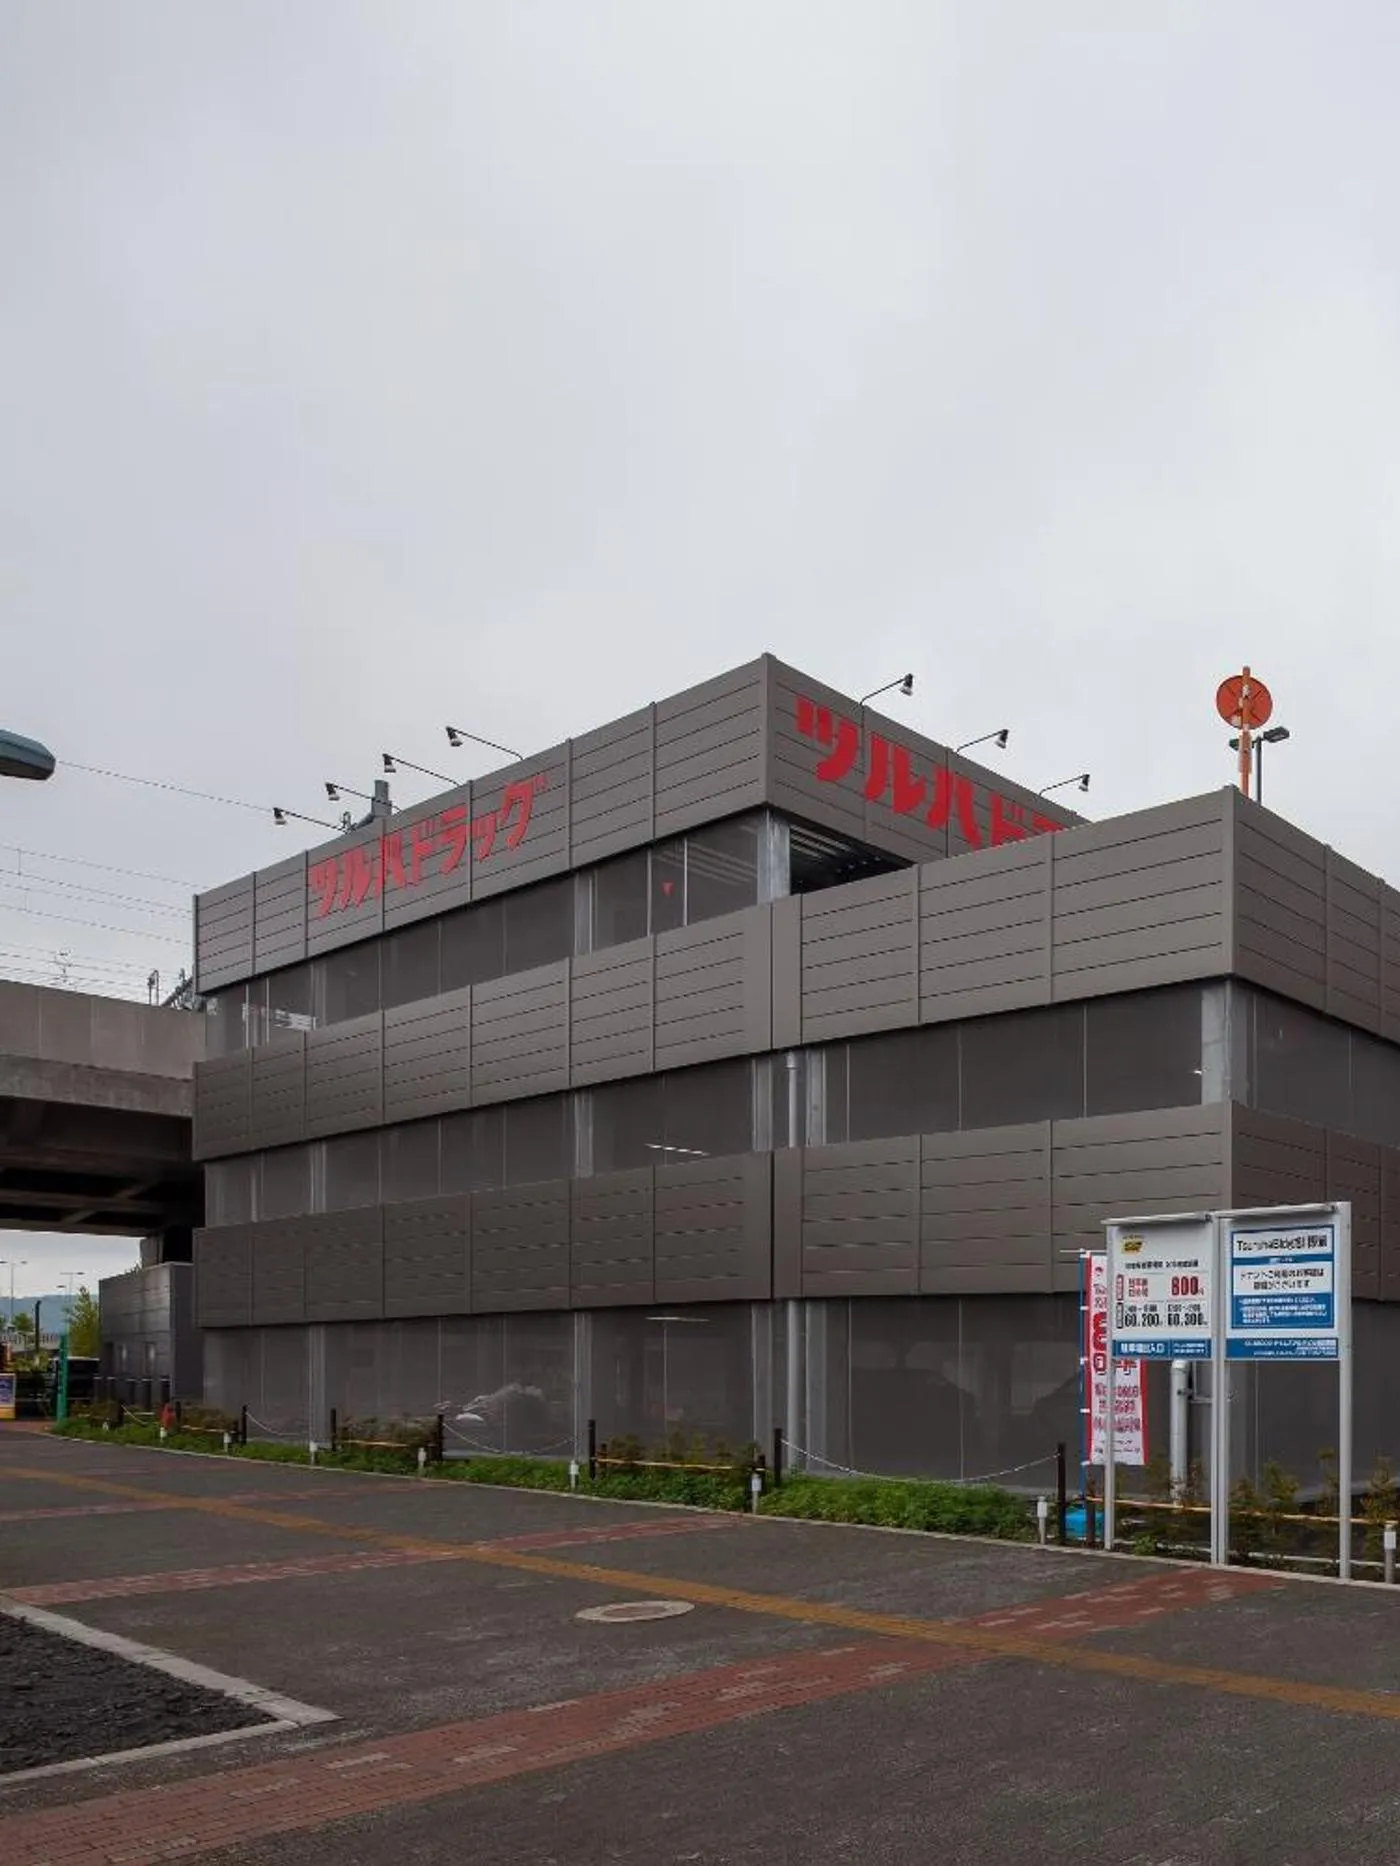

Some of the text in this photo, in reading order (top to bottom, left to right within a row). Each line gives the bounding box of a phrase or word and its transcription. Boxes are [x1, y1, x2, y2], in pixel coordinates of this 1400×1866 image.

[309, 774, 549, 917] ツルハドラッグ
